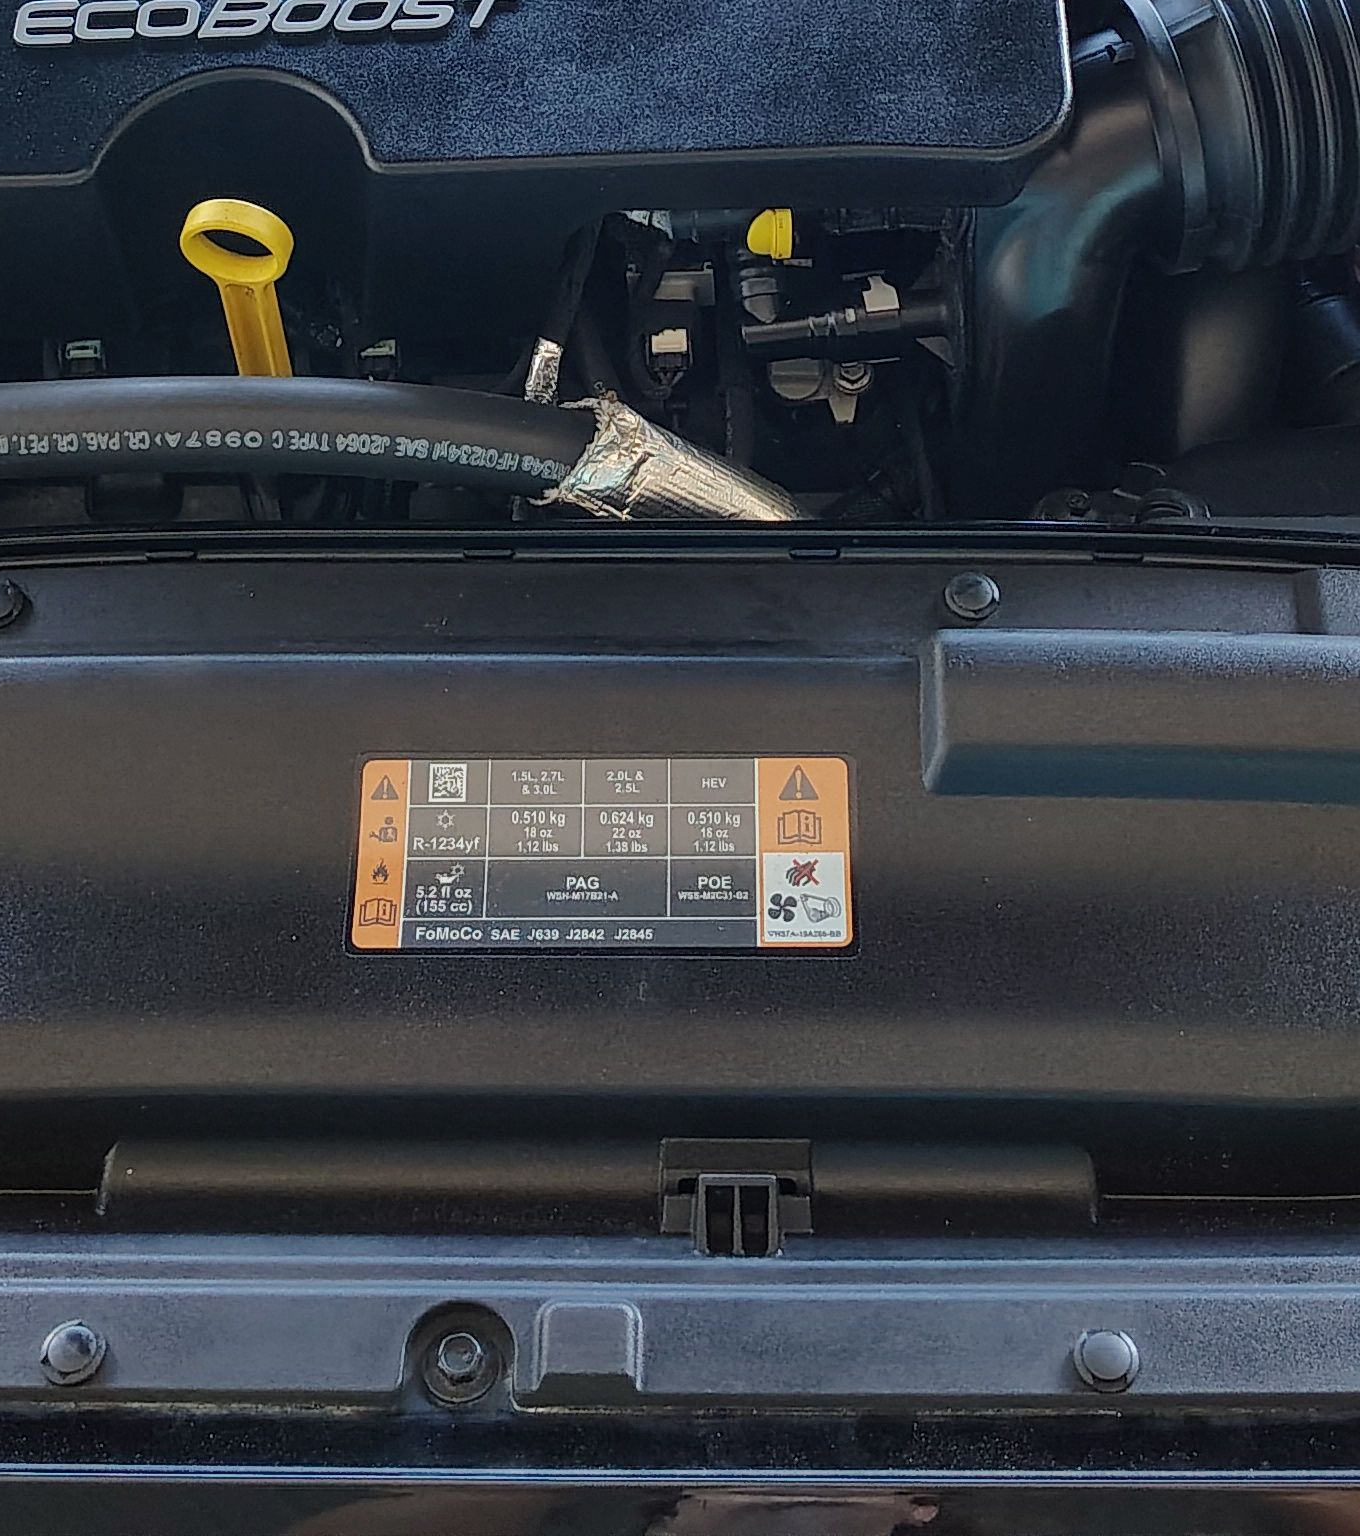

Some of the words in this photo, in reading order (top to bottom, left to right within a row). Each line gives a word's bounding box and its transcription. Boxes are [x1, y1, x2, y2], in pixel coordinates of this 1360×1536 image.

[272, 430, 283, 449] C
[289, 430, 330, 452] TYPE
[336, 434, 390, 454] J2064
[394, 438, 428, 460] SAE
[541, 772, 565, 782] 2.7L
[606, 771, 632, 781] 2.0L
[635, 771, 644, 781] &
[522, 785, 531, 795] &
[534, 785, 557, 795] 3.0L
[615, 783, 640, 793] 2.5L
[701, 778, 727, 789] HEV
[511, 810, 546, 824] 0.510
[549, 810, 566, 827] kg
[599, 811, 634, 825] 0.624
[638, 810, 655, 828] kg
[687, 811, 722, 825] 0.510
[725, 811, 741, 828] kg
[524, 827, 537, 838] 18
[539, 829, 553, 838] oz
[612, 827, 625, 839] 22
[628, 830, 642, 839] oz
[715, 829, 729, 838] oz
[412, 837, 480, 854] R-1234yf
[517, 840, 540, 853] 1.12
[542, 840, 559, 852] lbs
[631, 840, 648, 853] lbs
[694, 840, 716, 852] 1.12
[718, 840, 735, 852] lbs
[566, 876, 600, 889] PAG
[697, 876, 732, 889] POE
[415, 886, 438, 899] 5.2
[440, 885, 451, 899] fl
[455, 888, 472, 899] oz
[415, 900, 446, 914] (155
[450, 900, 473, 914] cc)
[415, 927, 483, 941] FoMoCo
[490, 929, 520, 941] SAE
[527, 929, 560, 941] J639
[566, 929, 605, 941] J2842
[614, 929, 654, 941] J2845
